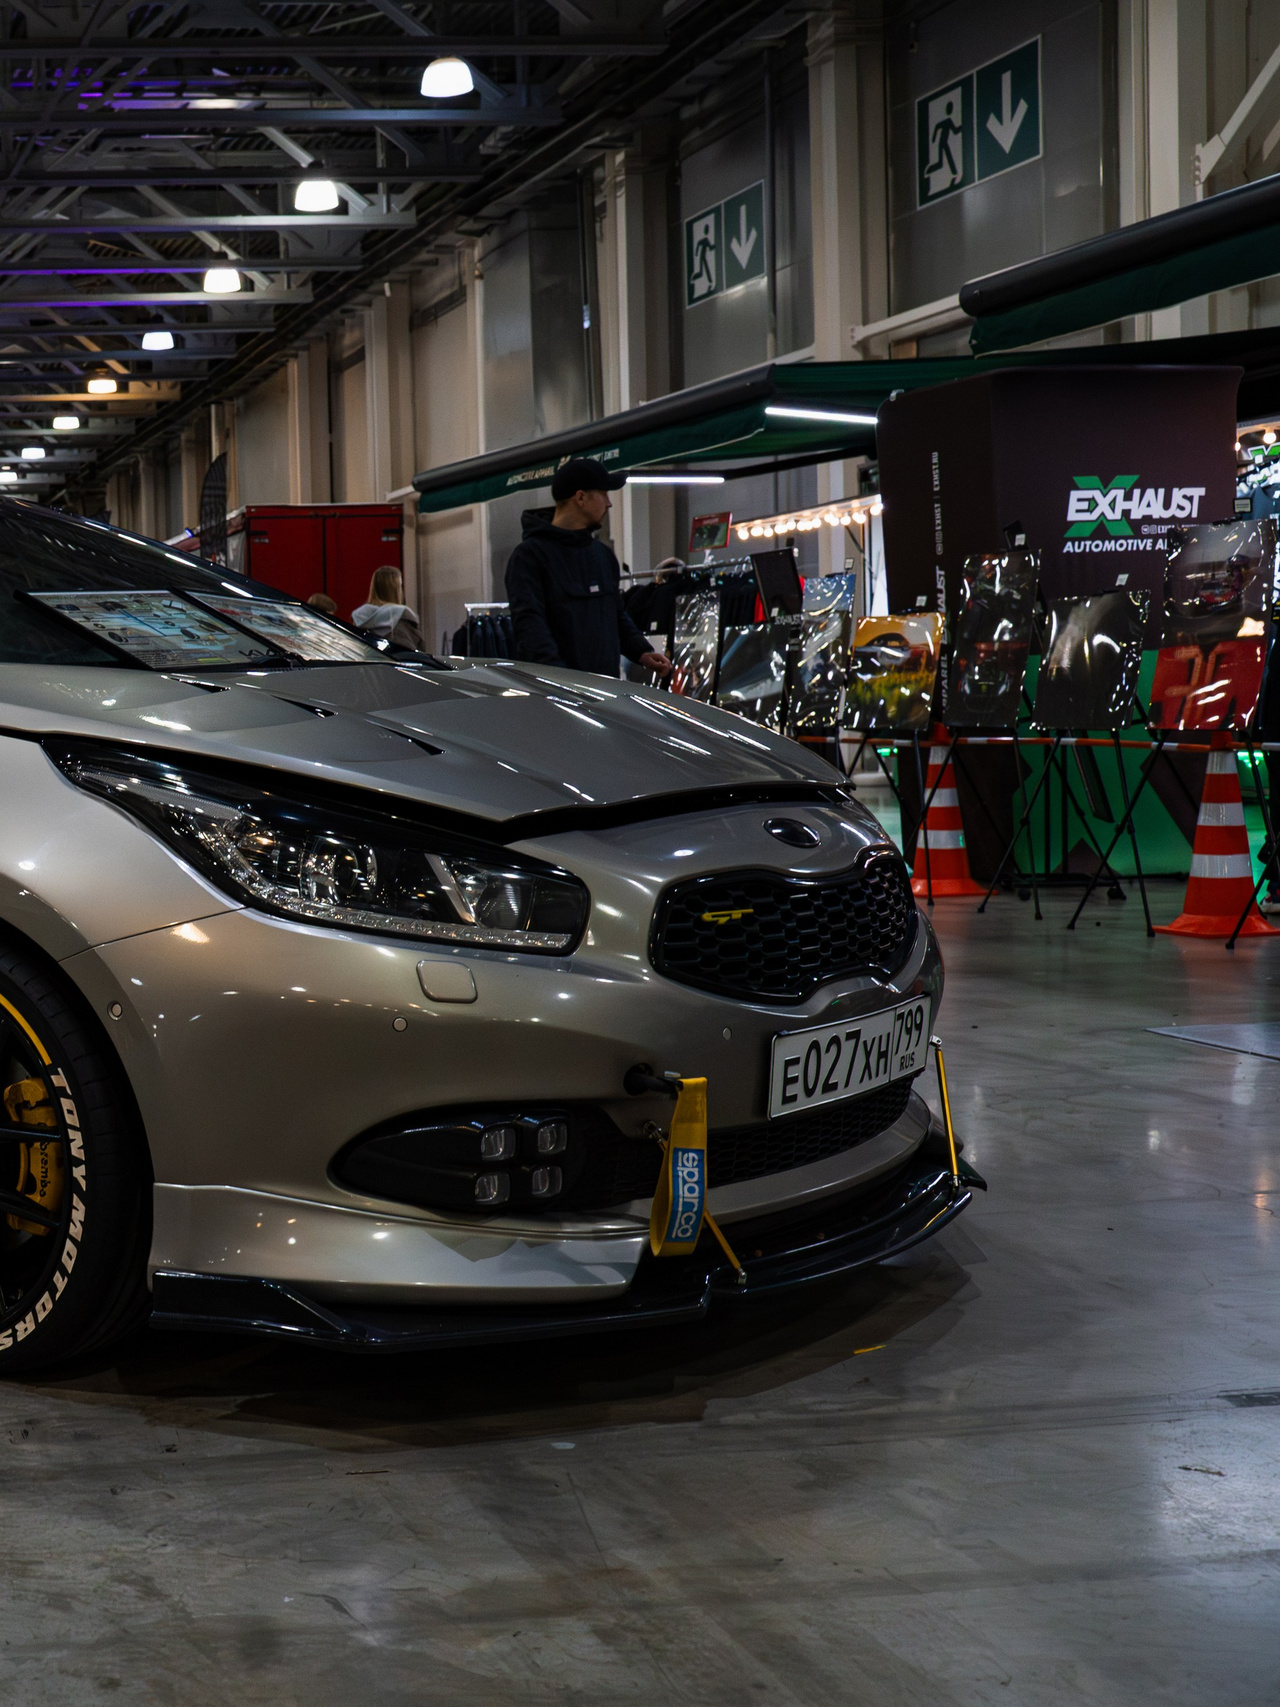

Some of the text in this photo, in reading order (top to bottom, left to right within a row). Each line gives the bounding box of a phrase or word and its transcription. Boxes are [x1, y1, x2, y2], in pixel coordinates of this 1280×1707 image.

[1065, 481, 1206, 529] EXHAUST
[1062, 538, 1154, 553] AUTOMOTIVE
[894, 1004, 924, 1056] 799
[899, 1051, 916, 1072] RUS
[50, 1067, 87, 1191] TONY
[675, 1151, 700, 1238] sparco
